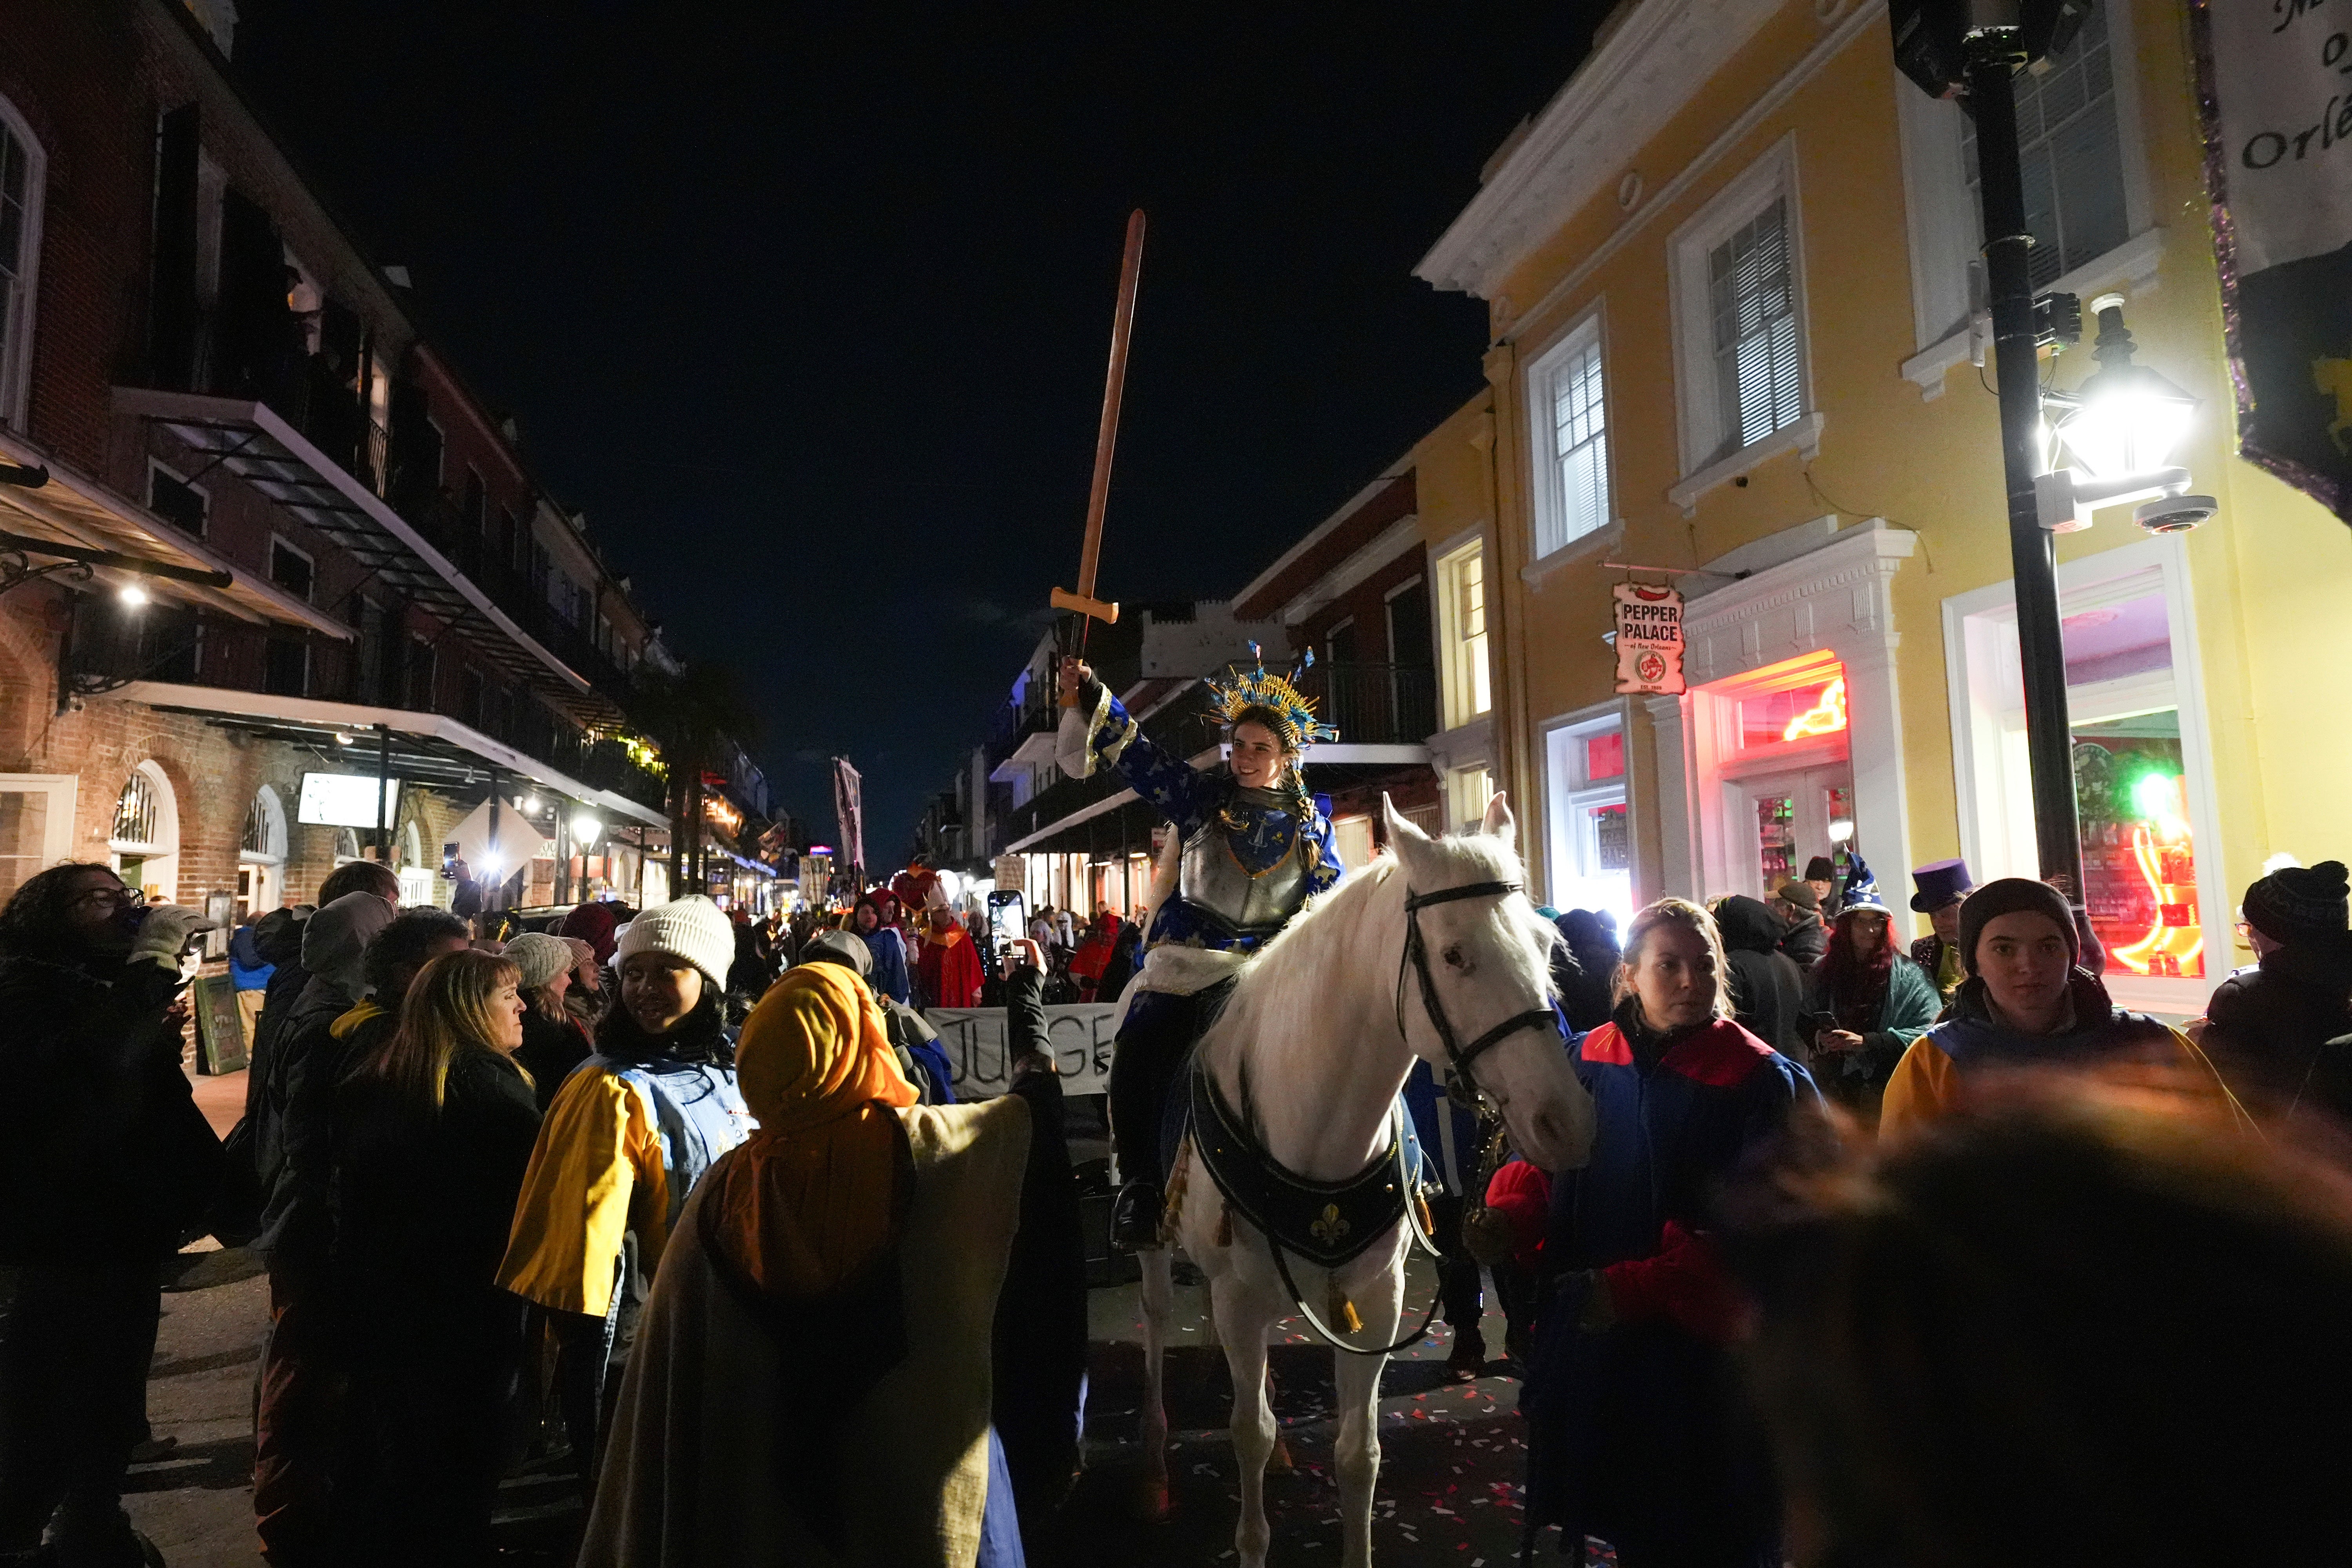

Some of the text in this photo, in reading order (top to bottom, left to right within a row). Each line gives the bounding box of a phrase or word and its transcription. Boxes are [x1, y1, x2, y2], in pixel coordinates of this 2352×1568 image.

[1623, 604, 1678, 622] PEPPER
[1624, 623, 1678, 641] PALACE
[941, 1013, 1114, 1085] JUGE
